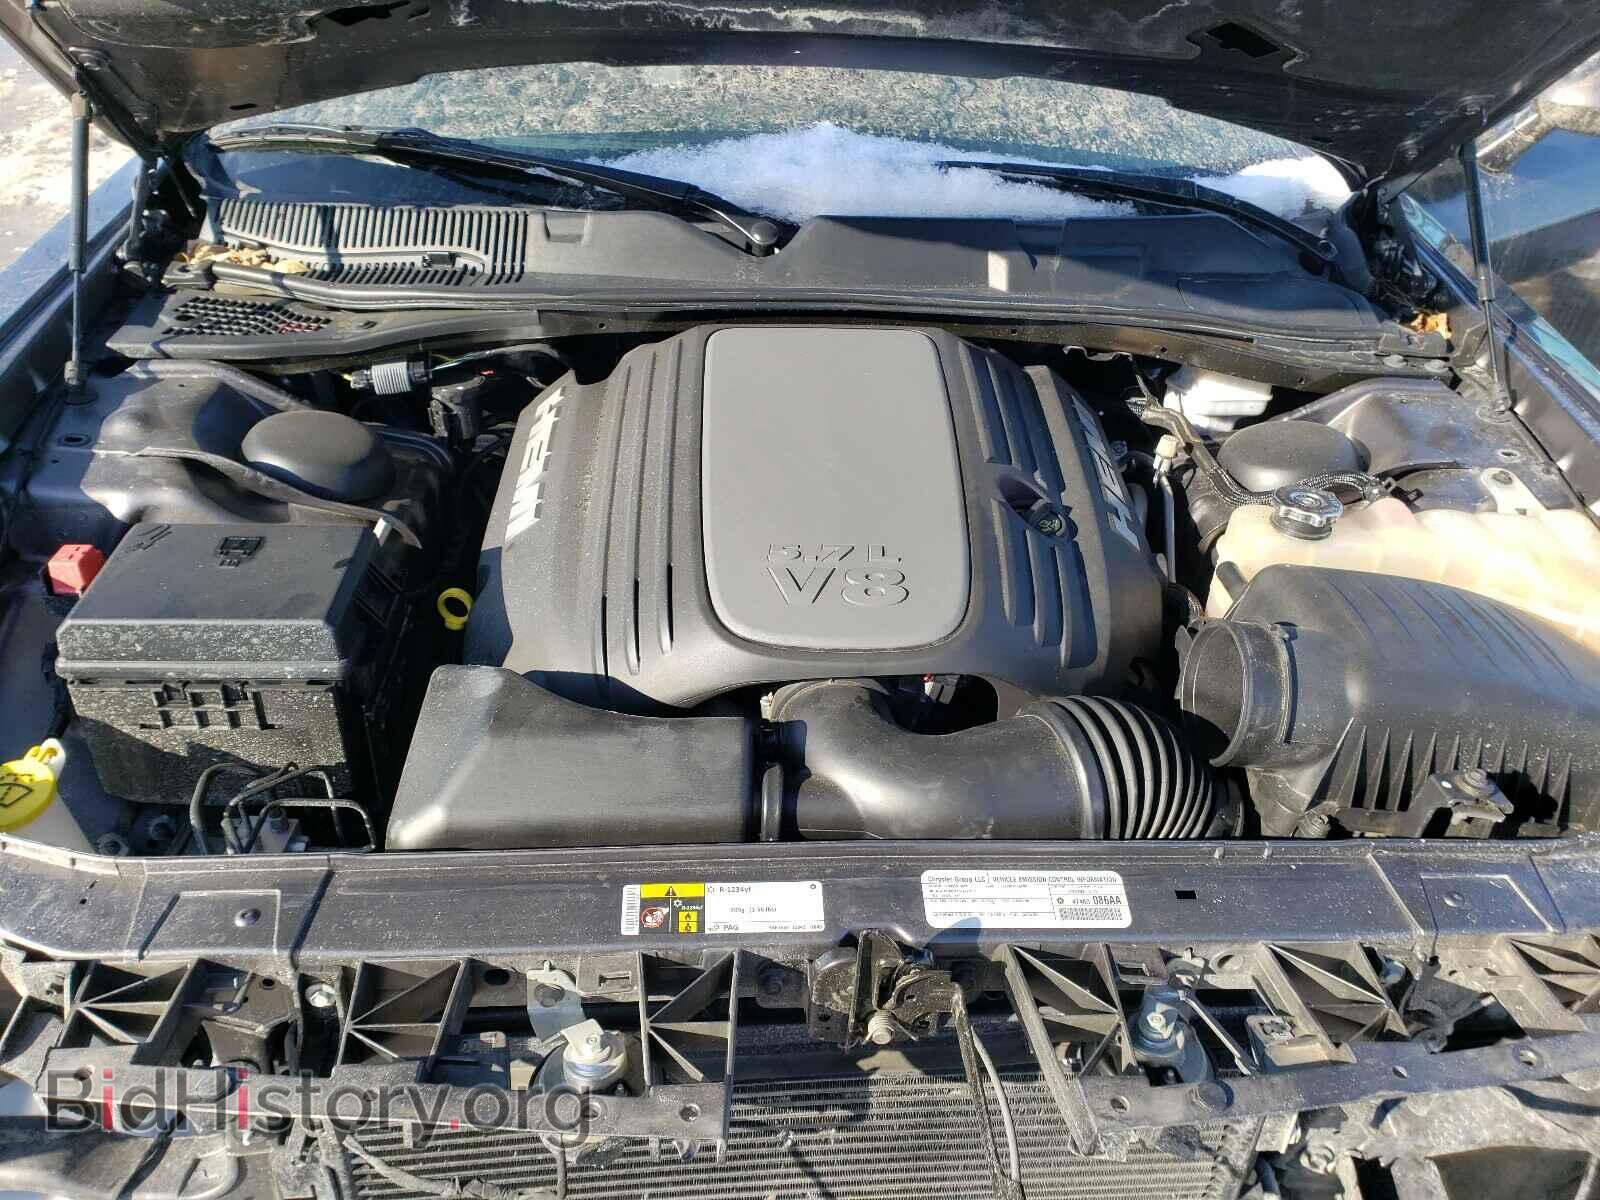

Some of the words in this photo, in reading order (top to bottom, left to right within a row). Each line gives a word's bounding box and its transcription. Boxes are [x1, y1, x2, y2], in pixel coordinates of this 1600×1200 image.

[505, 387, 566, 541] HEMI
[1071, 394, 1141, 552] HEMI
[766, 543, 902, 562] 5.7L
[766, 567, 910, 607] V8
[974, 875, 986, 883] LLC
[992, 875, 1017, 883] VEHICLE
[1018, 875, 1047, 883] EMISSION
[1048, 875, 1075, 883] CONTROL
[1076, 875, 1117, 883] INFORMATION
[719, 886, 751, 894] R-1234yf
[1091, 895, 1122, 905] 086AA
